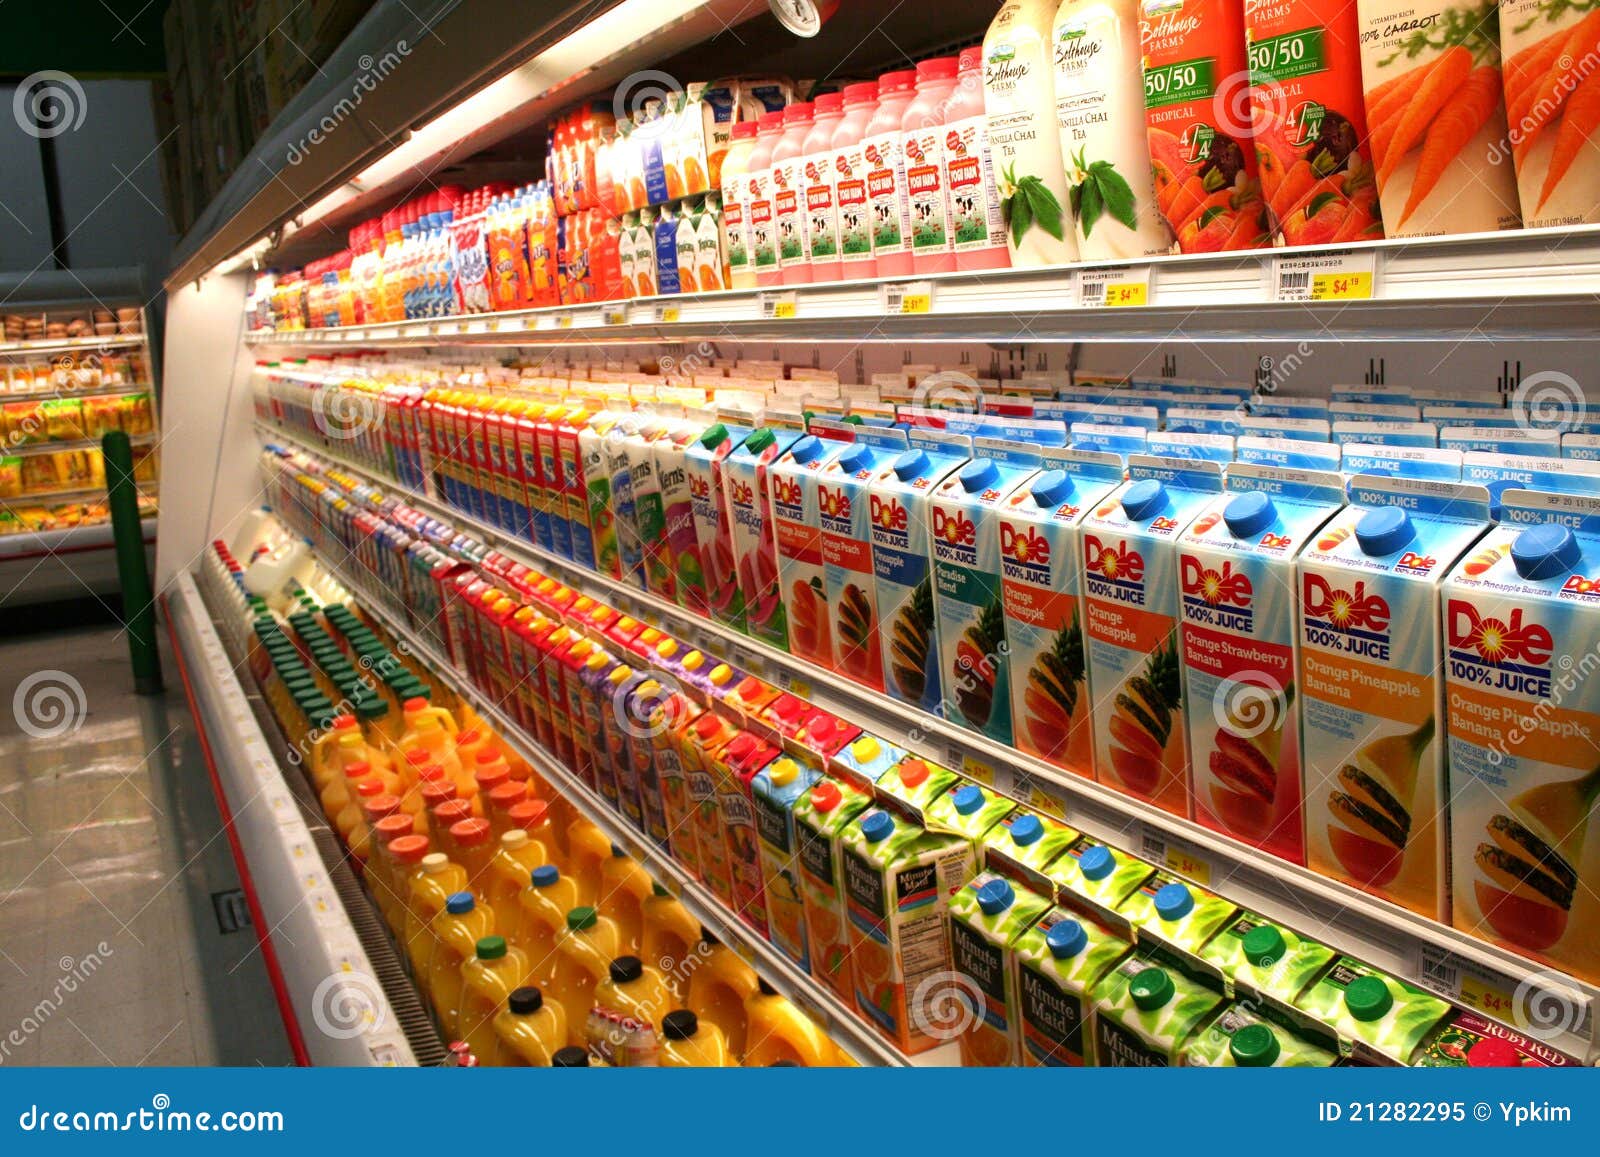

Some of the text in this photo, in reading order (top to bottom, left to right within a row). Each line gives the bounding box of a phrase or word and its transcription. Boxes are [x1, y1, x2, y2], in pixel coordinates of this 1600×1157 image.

[1254, 3, 1291, 23] FARMS
[1369, 9, 1415, 25] VITAMIN RICH
[1138, 12, 1201, 45] Bolthouse
[1383, 13, 1440, 38] CARROT
[1055, 37, 1102, 65] Bolthouse
[1150, 35, 1184, 52] FARMS
[1248, 38, 1304, 72] 50/50
[986, 60, 1029, 85] Bolthouse
[1061, 59, 1088, 72] FARMS
[1145, 66, 1197, 97] 50/50
[1255, 84, 1303, 103] TROPICAL
[1085, 112, 1108, 124] CHAI
[1150, 107, 1196, 124] TROPICAL
[1014, 130, 1036, 142] CHAI
[1072, 128, 1086, 140] TEA
[1002, 145, 1016, 156] TEA
[1333, 279, 1348, 294] $4
[1348, 457, 1400, 471] 100% JUICE
[1570, 449, 1599, 460] 100%
[1063, 462, 1081, 472] JUICE
[1132, 467, 1175, 481] 100% JUICE
[1470, 468, 1533, 484] 100% JUICE
[688, 472, 709, 497] Dole
[730, 478, 753, 505] Dole
[773, 473, 802, 504] Dole
[1232, 478, 1283, 493] 100% JUICE
[818, 484, 851, 518] Dole
[1359, 491, 1418, 508] 100% JUICE
[869, 494, 908, 530] Dole
[1153, 516, 1178, 530] Dole
[1509, 509, 1582, 528] 100% JUICE
[932, 506, 976, 546] Dole
[873, 531, 909, 549] 100% JUICE
[999, 521, 1051, 564] Dole
[1261, 533, 1292, 549] Dole
[935, 544, 977, 566] 100% JUICE
[1084, 534, 1145, 581] Dole
[1307, 551, 1390, 571] Orange Pineapple Banana
[1399, 552, 1436, 570] Dole
[1003, 563, 1051, 586] 100% JUICE
[1180, 554, 1254, 607] Dole
[1454, 575, 1553, 597] Orange Pineapple Banana
[1005, 584, 1033, 605] Orange
[1087, 580, 1145, 606] 100% JUICE
[1303, 572, 1391, 632] Dole
[1088, 603, 1123, 626] Orange
[1184, 604, 1254, 634] 100% JUICE
[1089, 619, 1137, 644] Pineapple
[1448, 598, 1554, 666] Dole
[1186, 631, 1288, 669] Orange Strawberry
[1304, 627, 1390, 661] 100% JUICE
[1187, 647, 1223, 670] Banana
[1306, 657, 1421, 698] Orange Pineapple
[1306, 675, 1350, 699] Banana
[1450, 660, 1552, 699] 100% JUICE
[1451, 693, 1591, 739] Orange Pineapple
[1452, 710, 1501, 740] Banana
[845, 853, 880, 891] Minute
[900, 869, 932, 884] Minute
[905, 877, 928, 891] Maid
[850, 873, 876, 899] Maid
[954, 926, 1000, 968] Minute
[960, 948, 992, 985] Maid
[1023, 973, 1075, 1020] Minute
[1031, 998, 1066, 1034] Maid
[1484, 1022, 1528, 1048] RUBY
